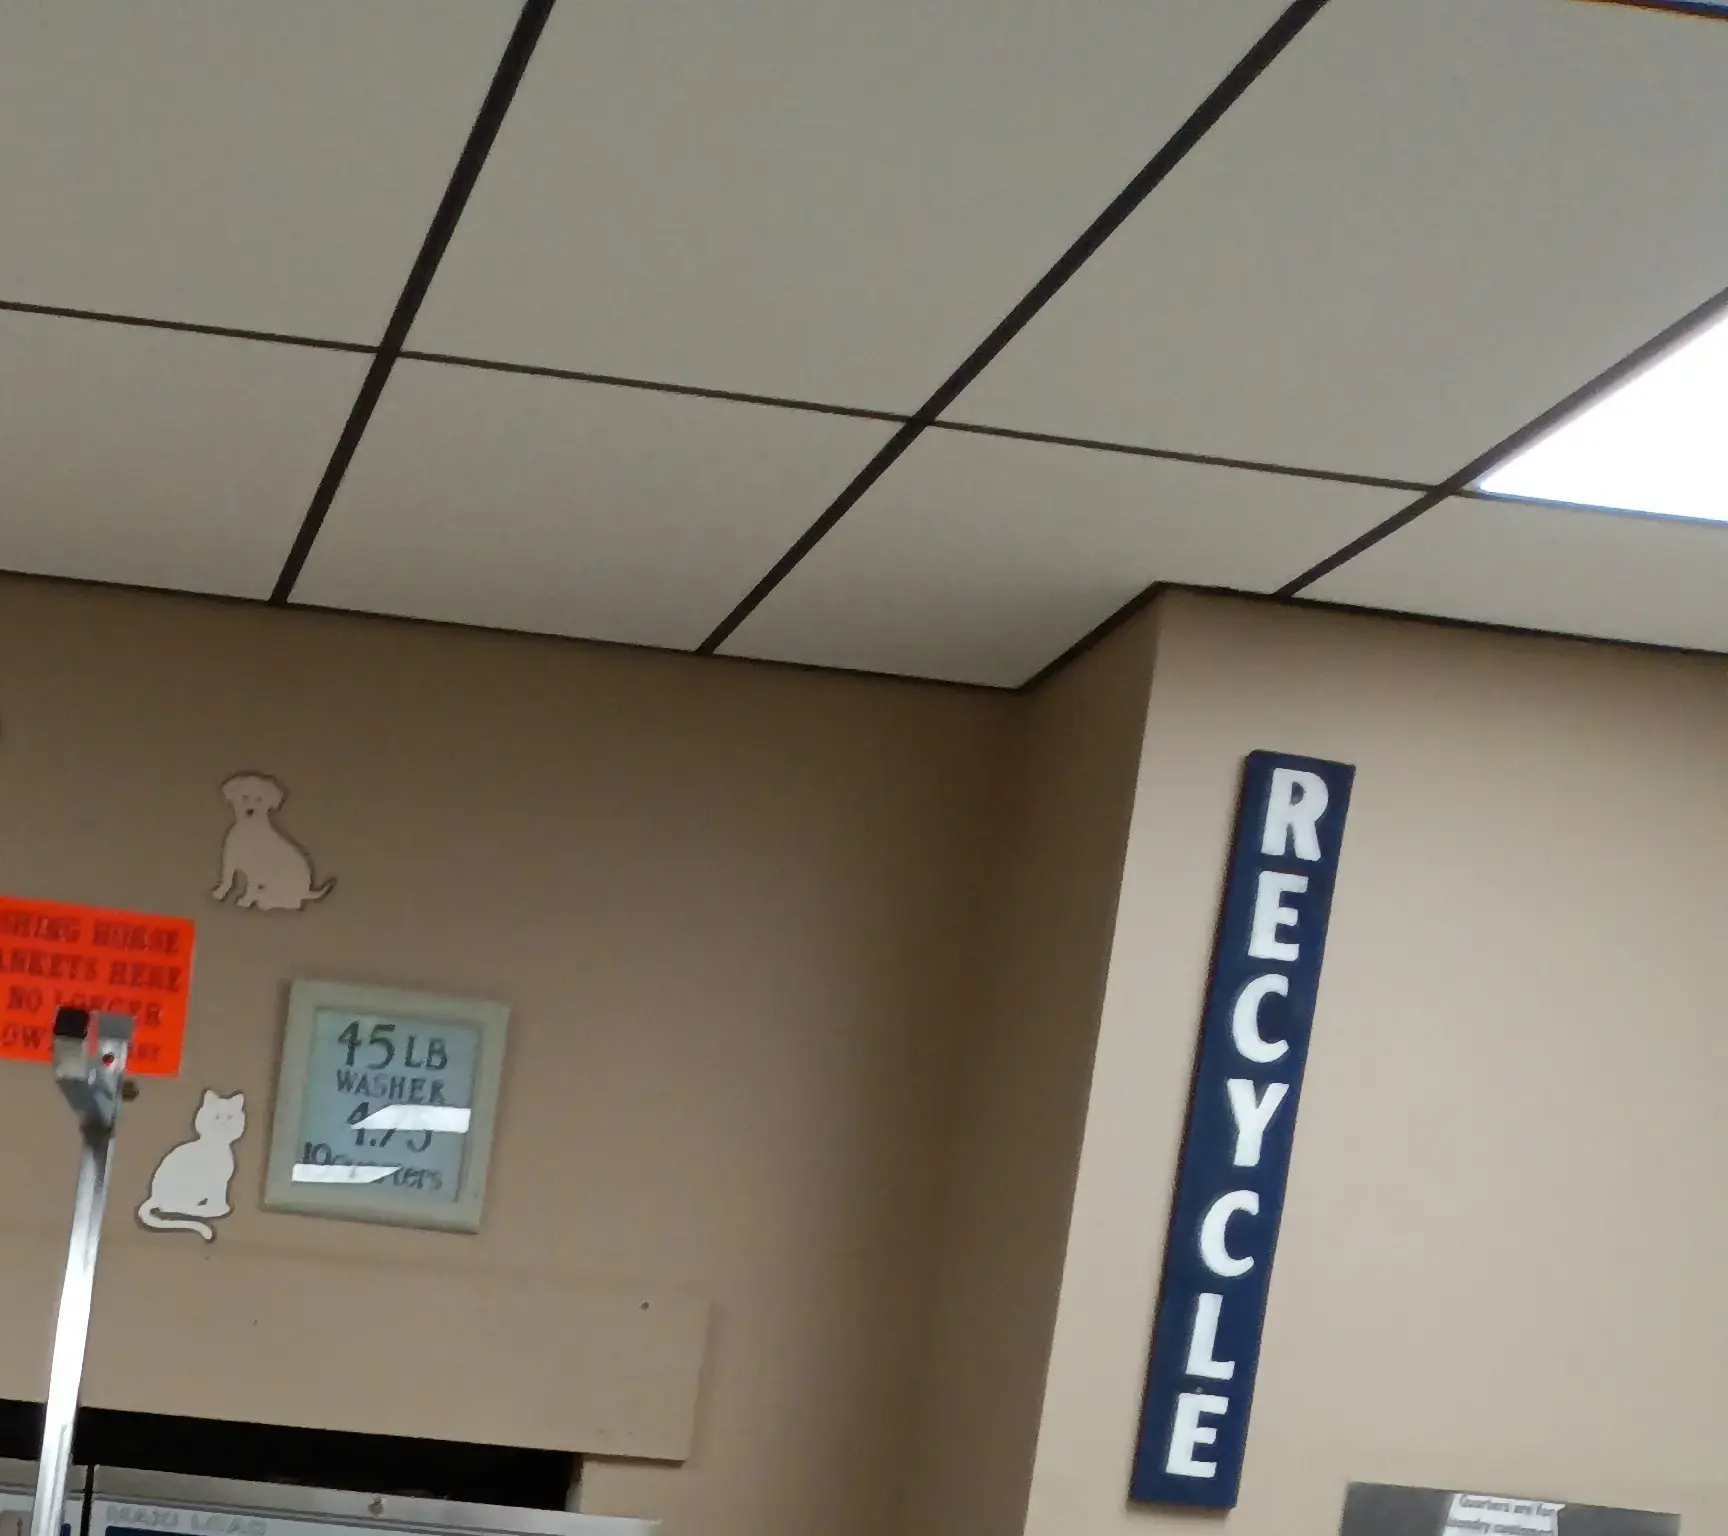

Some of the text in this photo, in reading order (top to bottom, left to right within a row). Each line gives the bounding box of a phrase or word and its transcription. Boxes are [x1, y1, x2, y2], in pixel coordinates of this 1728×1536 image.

[93, 919, 180, 954] HORSE
[109, 962, 182, 992] HERE
[7, 985, 43, 1013] NO
[337, 1020, 448, 1071] 45 LB
[336, 1068, 446, 1105] WASHER
[1166, 767, 1329, 1478] RECYCLE
